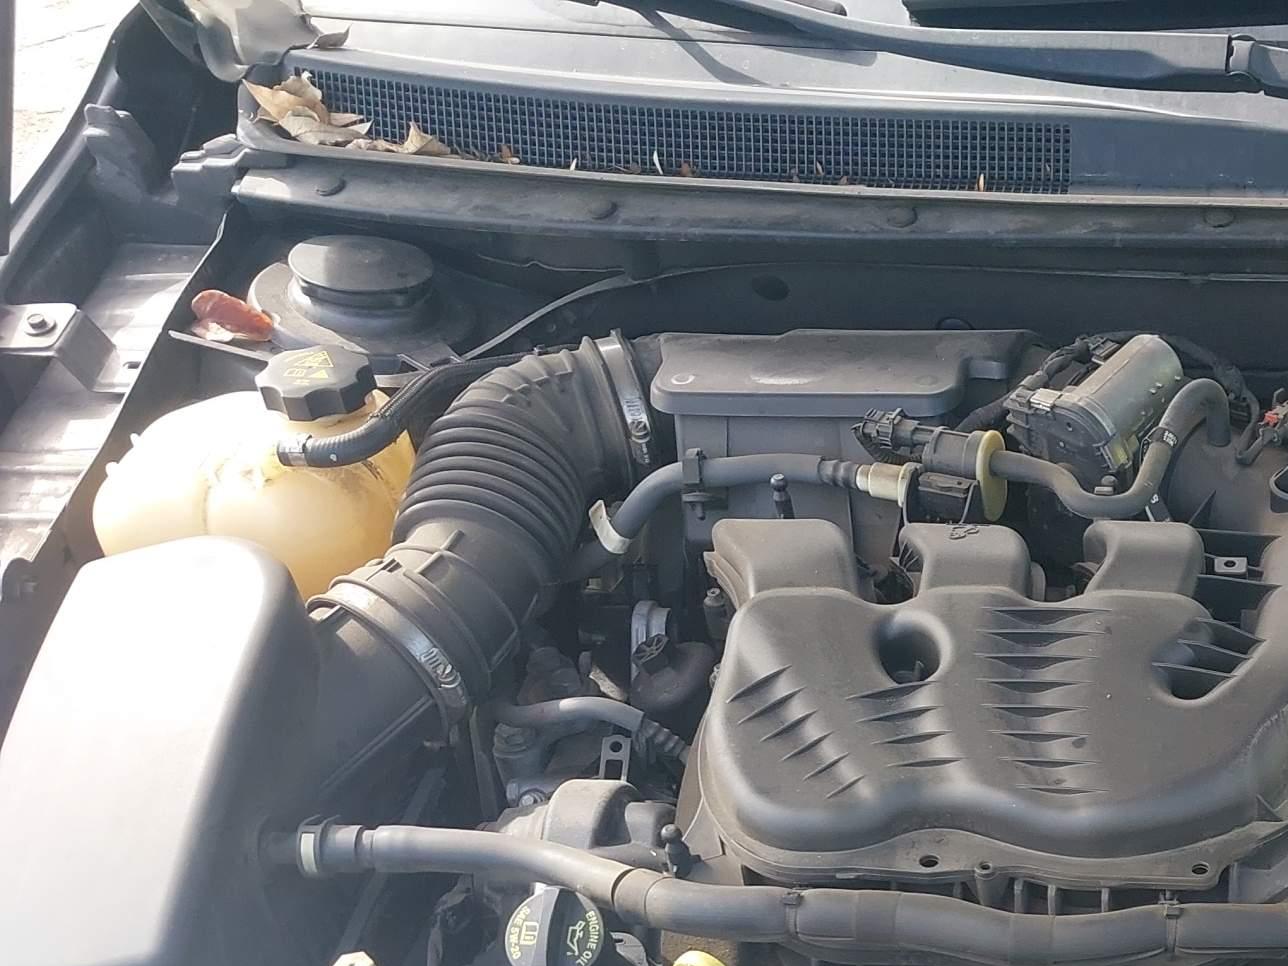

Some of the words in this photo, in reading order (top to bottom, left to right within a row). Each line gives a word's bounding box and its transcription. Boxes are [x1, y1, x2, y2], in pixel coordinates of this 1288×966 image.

[513, 906, 531, 925] SAE
[510, 927, 522, 960] 5W-20
[585, 911, 600, 950] ENGINE
[576, 951, 592, 966] OIL
